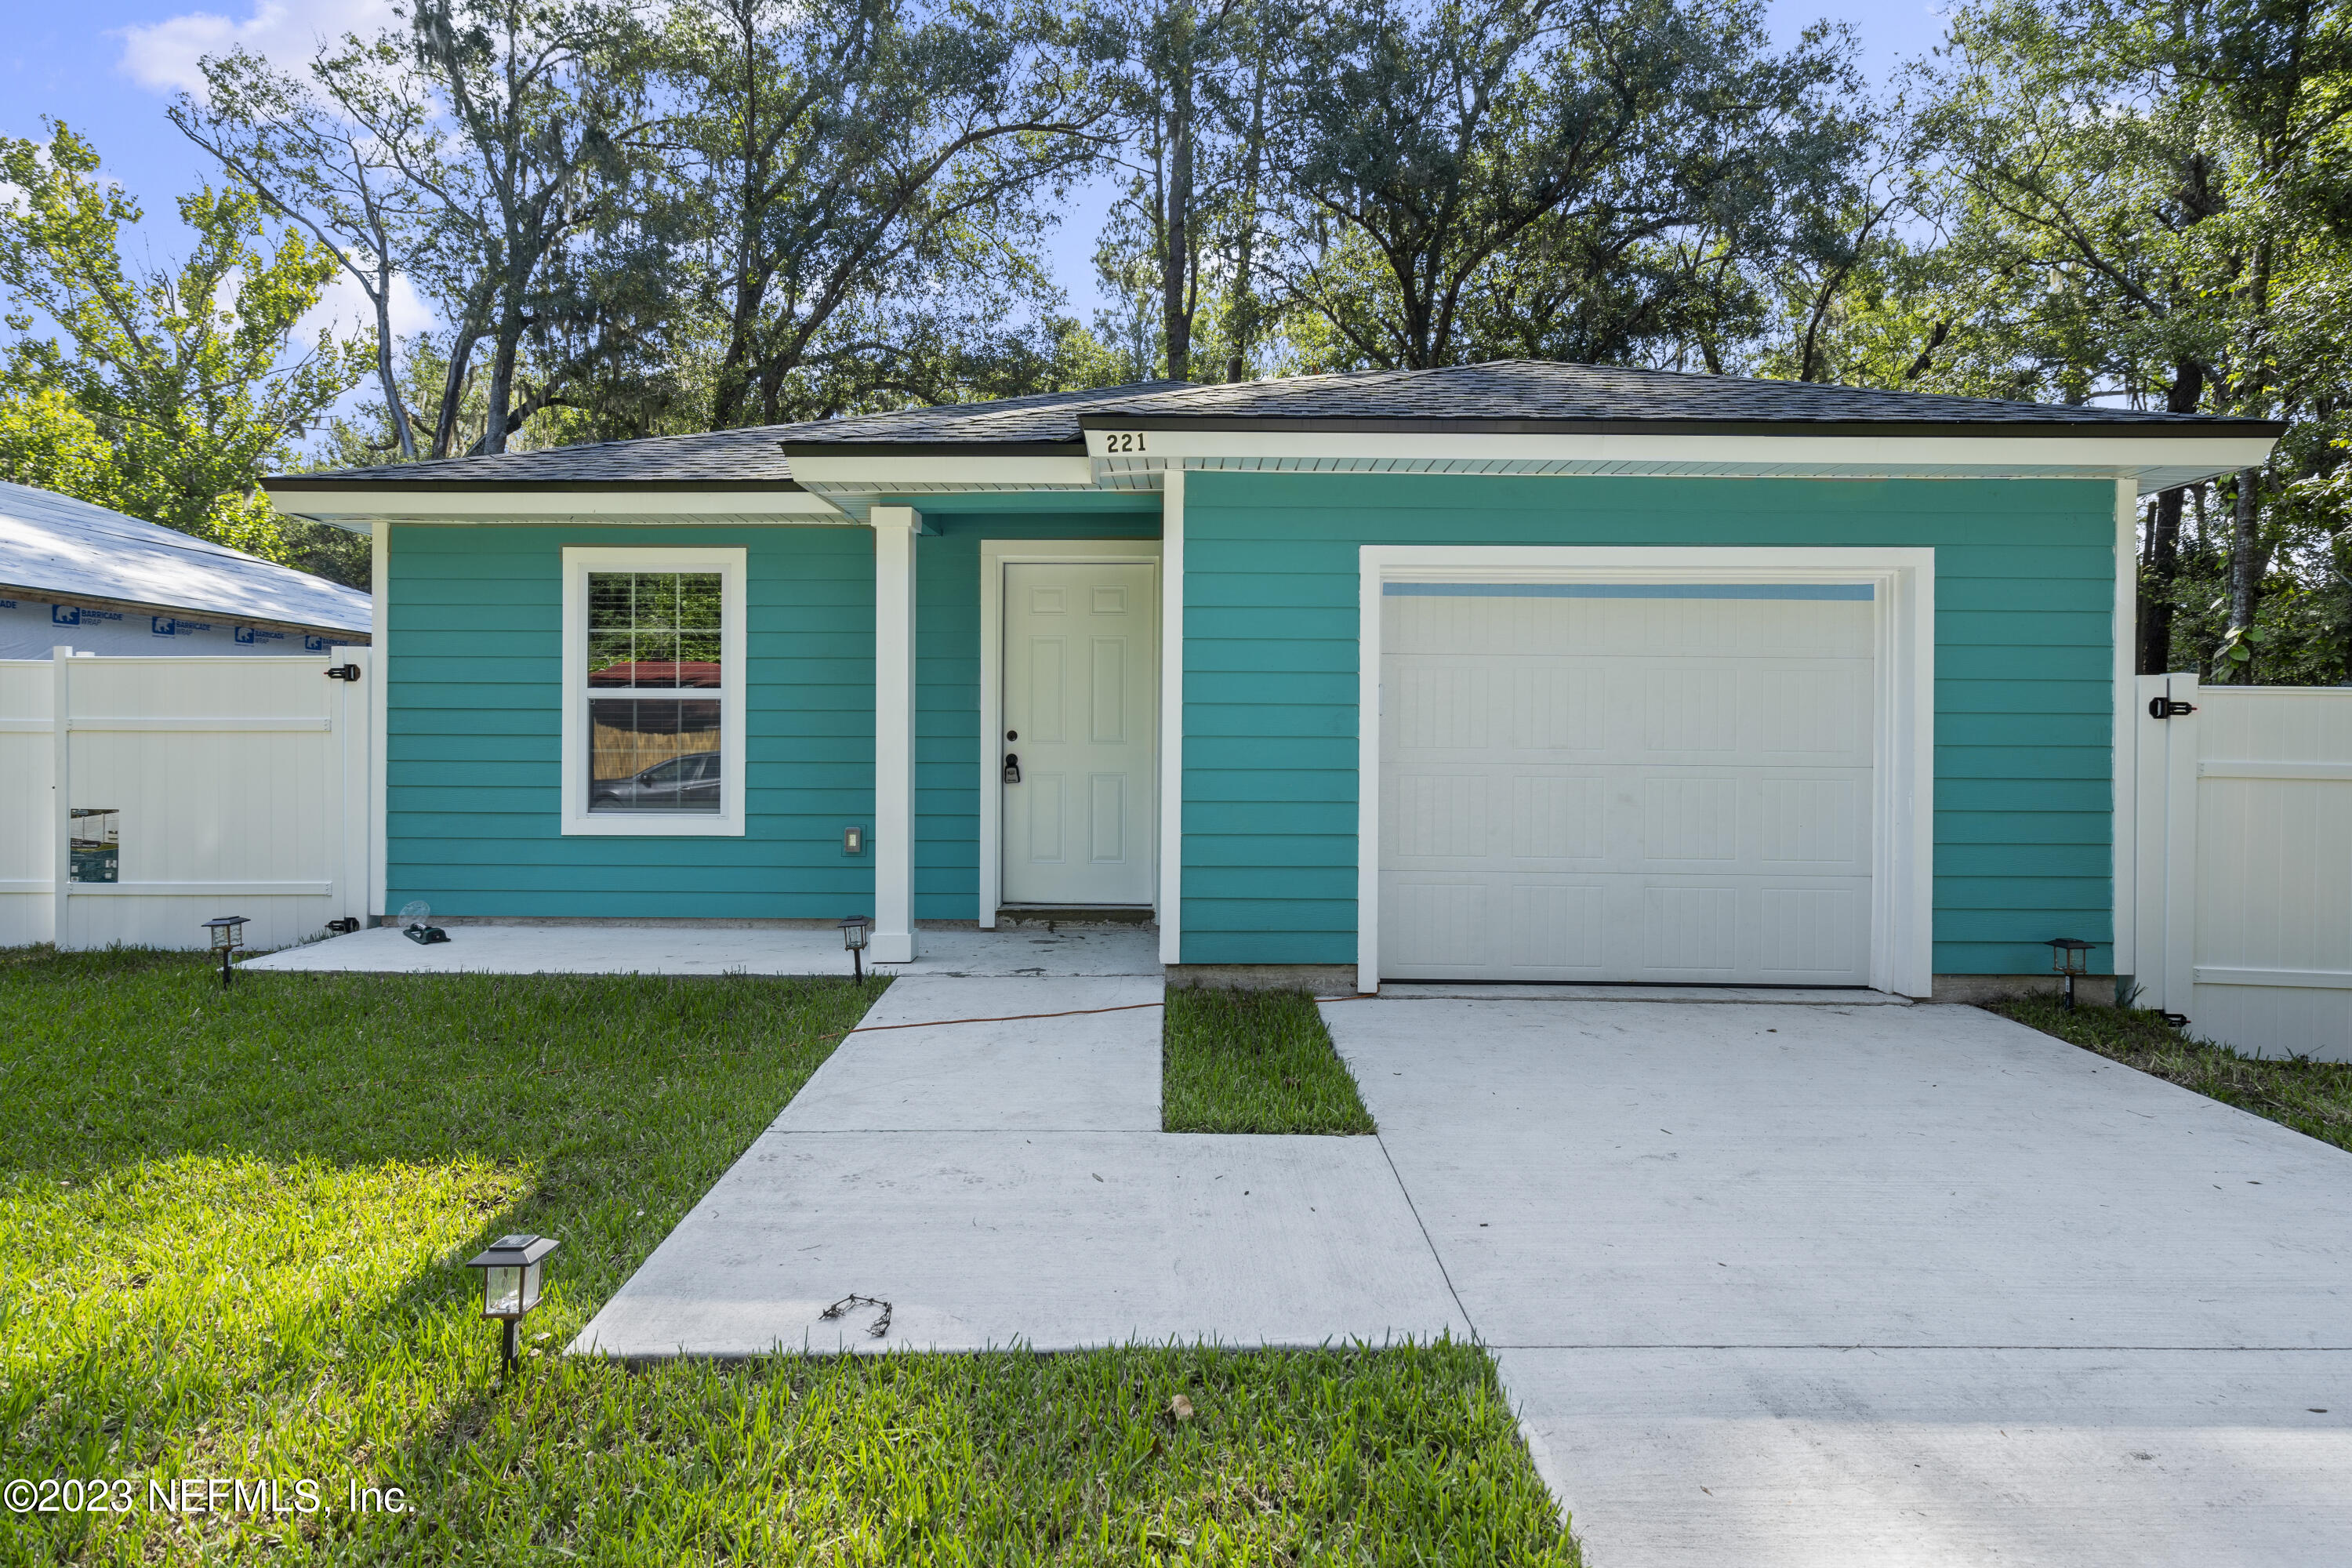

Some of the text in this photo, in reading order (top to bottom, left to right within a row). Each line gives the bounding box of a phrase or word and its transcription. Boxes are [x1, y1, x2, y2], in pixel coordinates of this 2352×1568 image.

[1106, 432, 1146, 453] 221
[81, 609, 123, 621] BARRICADE
[81, 617, 102, 626] WRAP
[176, 620, 212, 631] BARRICADE
